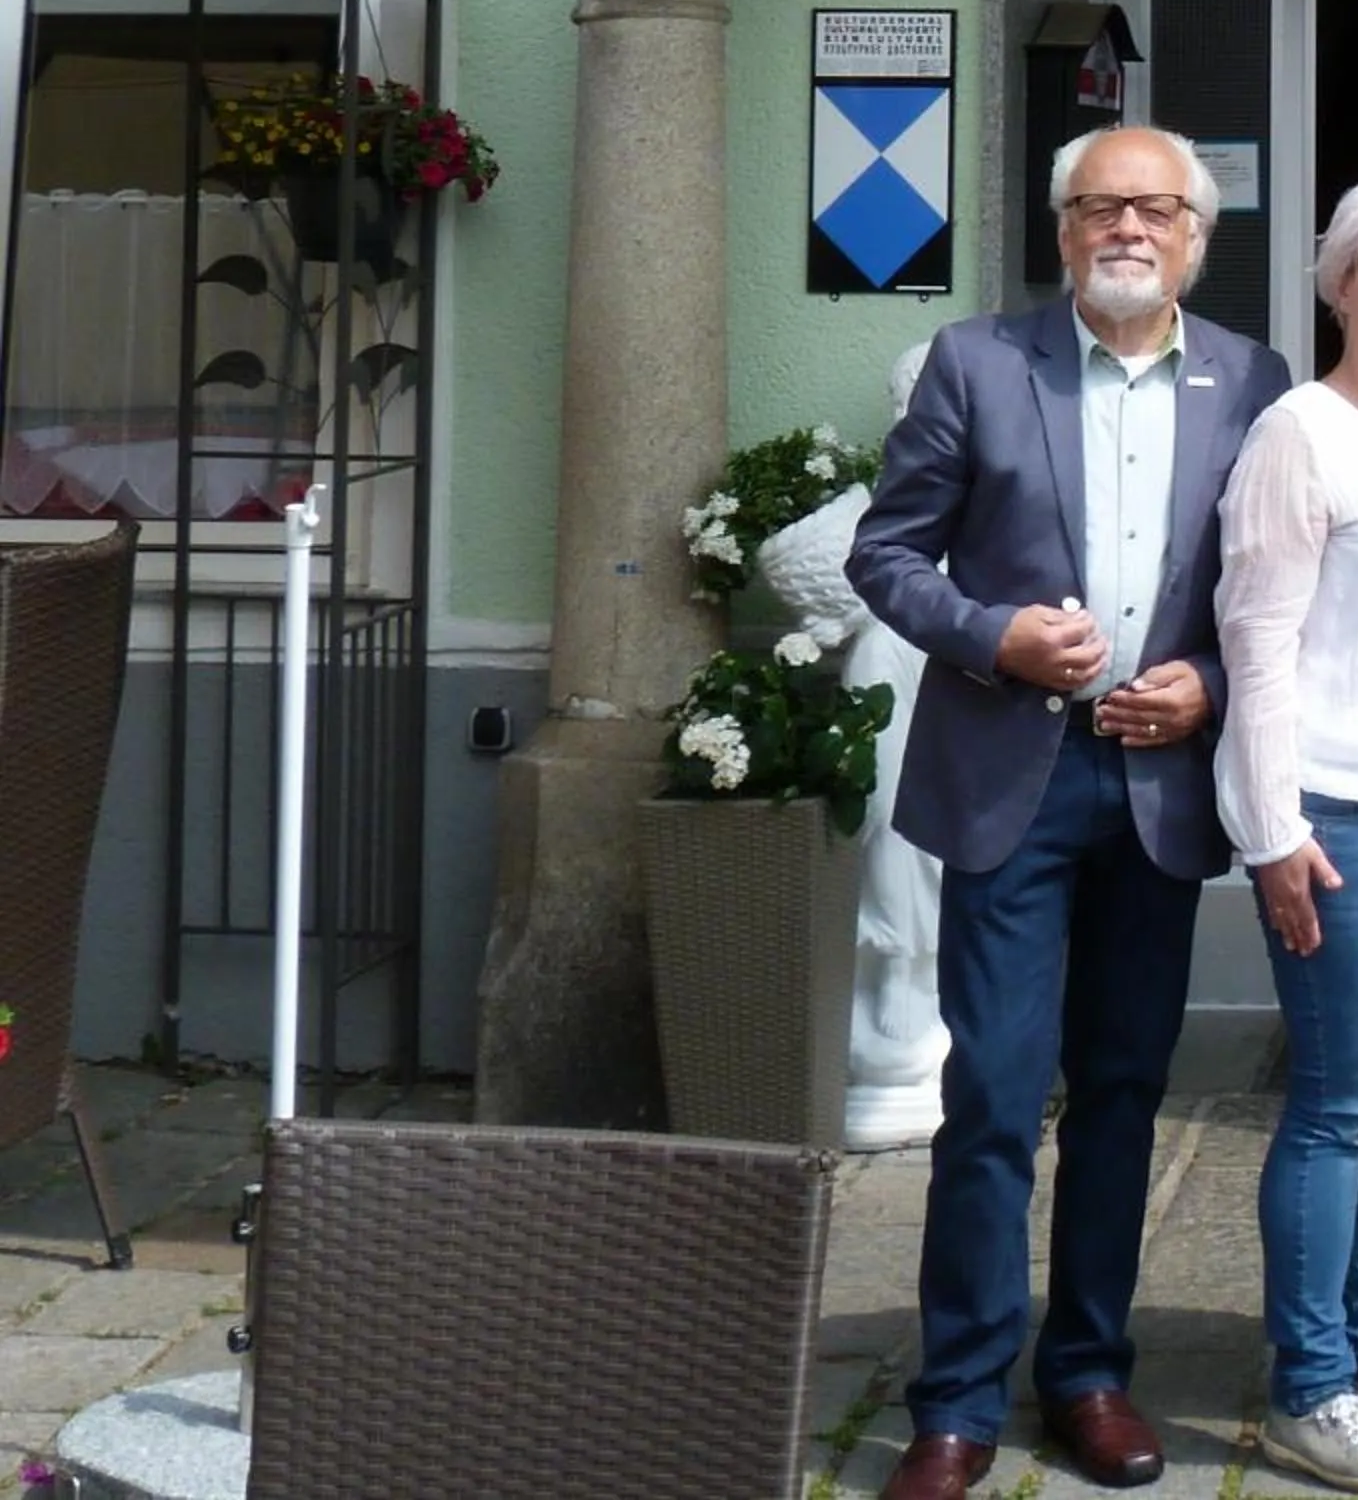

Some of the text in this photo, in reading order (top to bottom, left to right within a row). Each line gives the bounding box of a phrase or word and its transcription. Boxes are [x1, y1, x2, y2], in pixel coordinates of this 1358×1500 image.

[825, 16, 943, 25] KULTURDENKMAL
[824, 25, 943, 34] CULTURAL PROPERTY
[824, 35, 943, 43] BIEN CULTUREL
